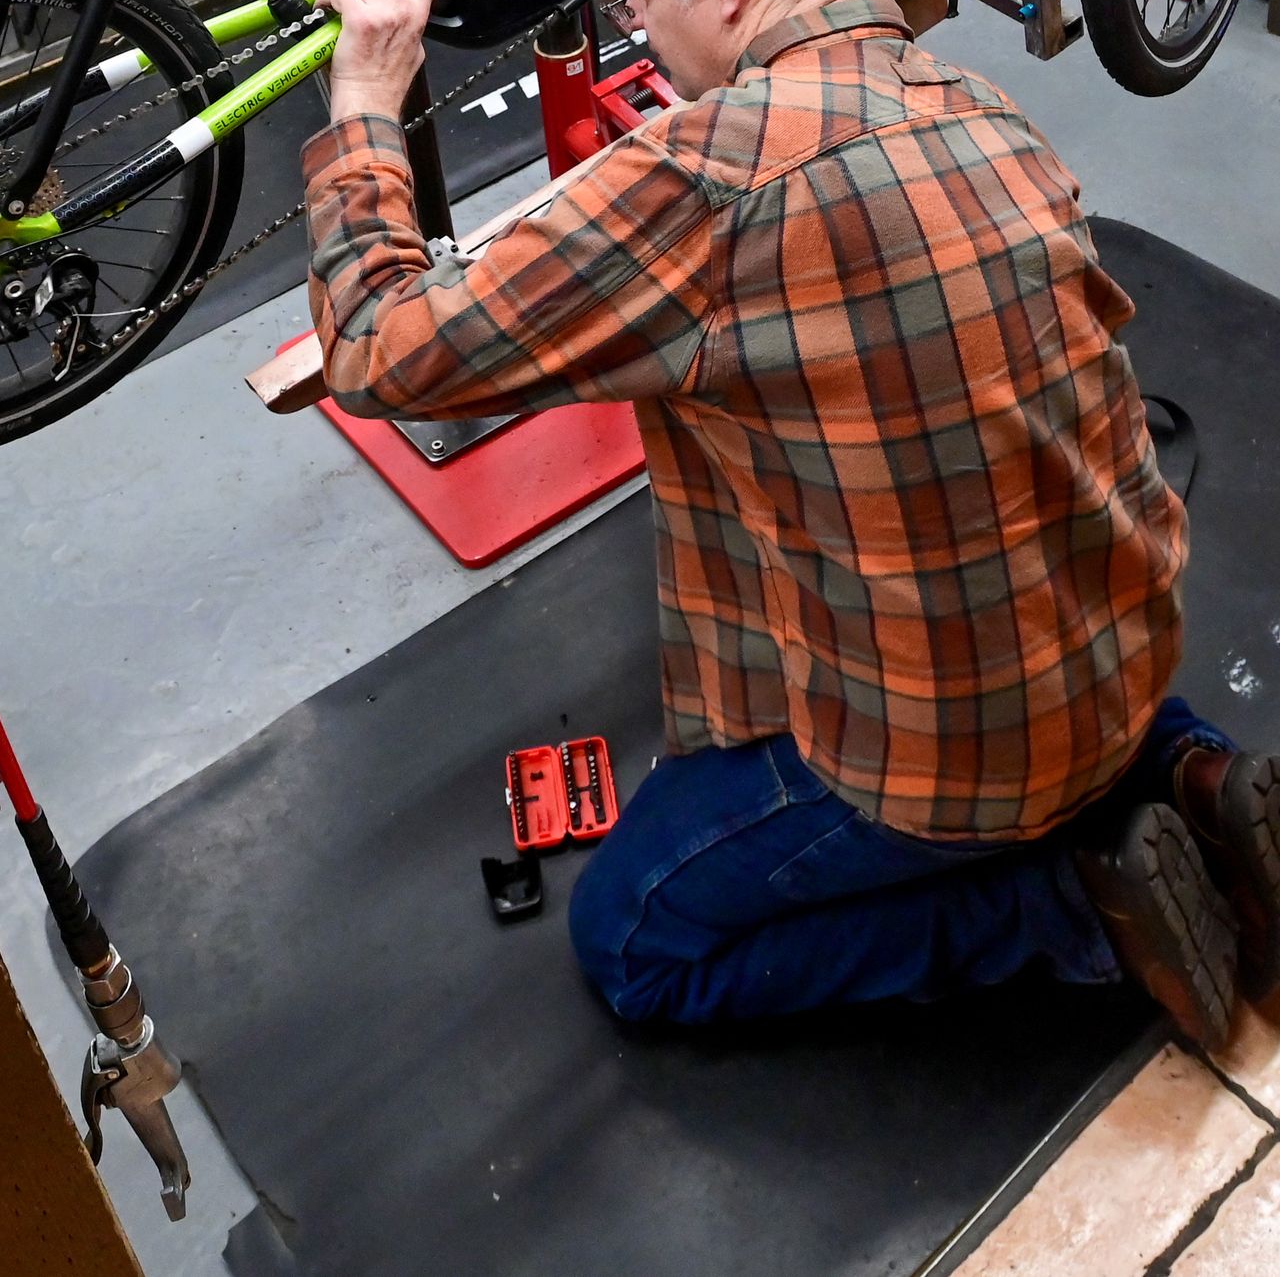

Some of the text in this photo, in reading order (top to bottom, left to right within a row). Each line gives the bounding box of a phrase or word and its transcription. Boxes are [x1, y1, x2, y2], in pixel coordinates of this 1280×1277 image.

[215, 35, 340, 133] ELECTRIC VEHICLE OPTI
